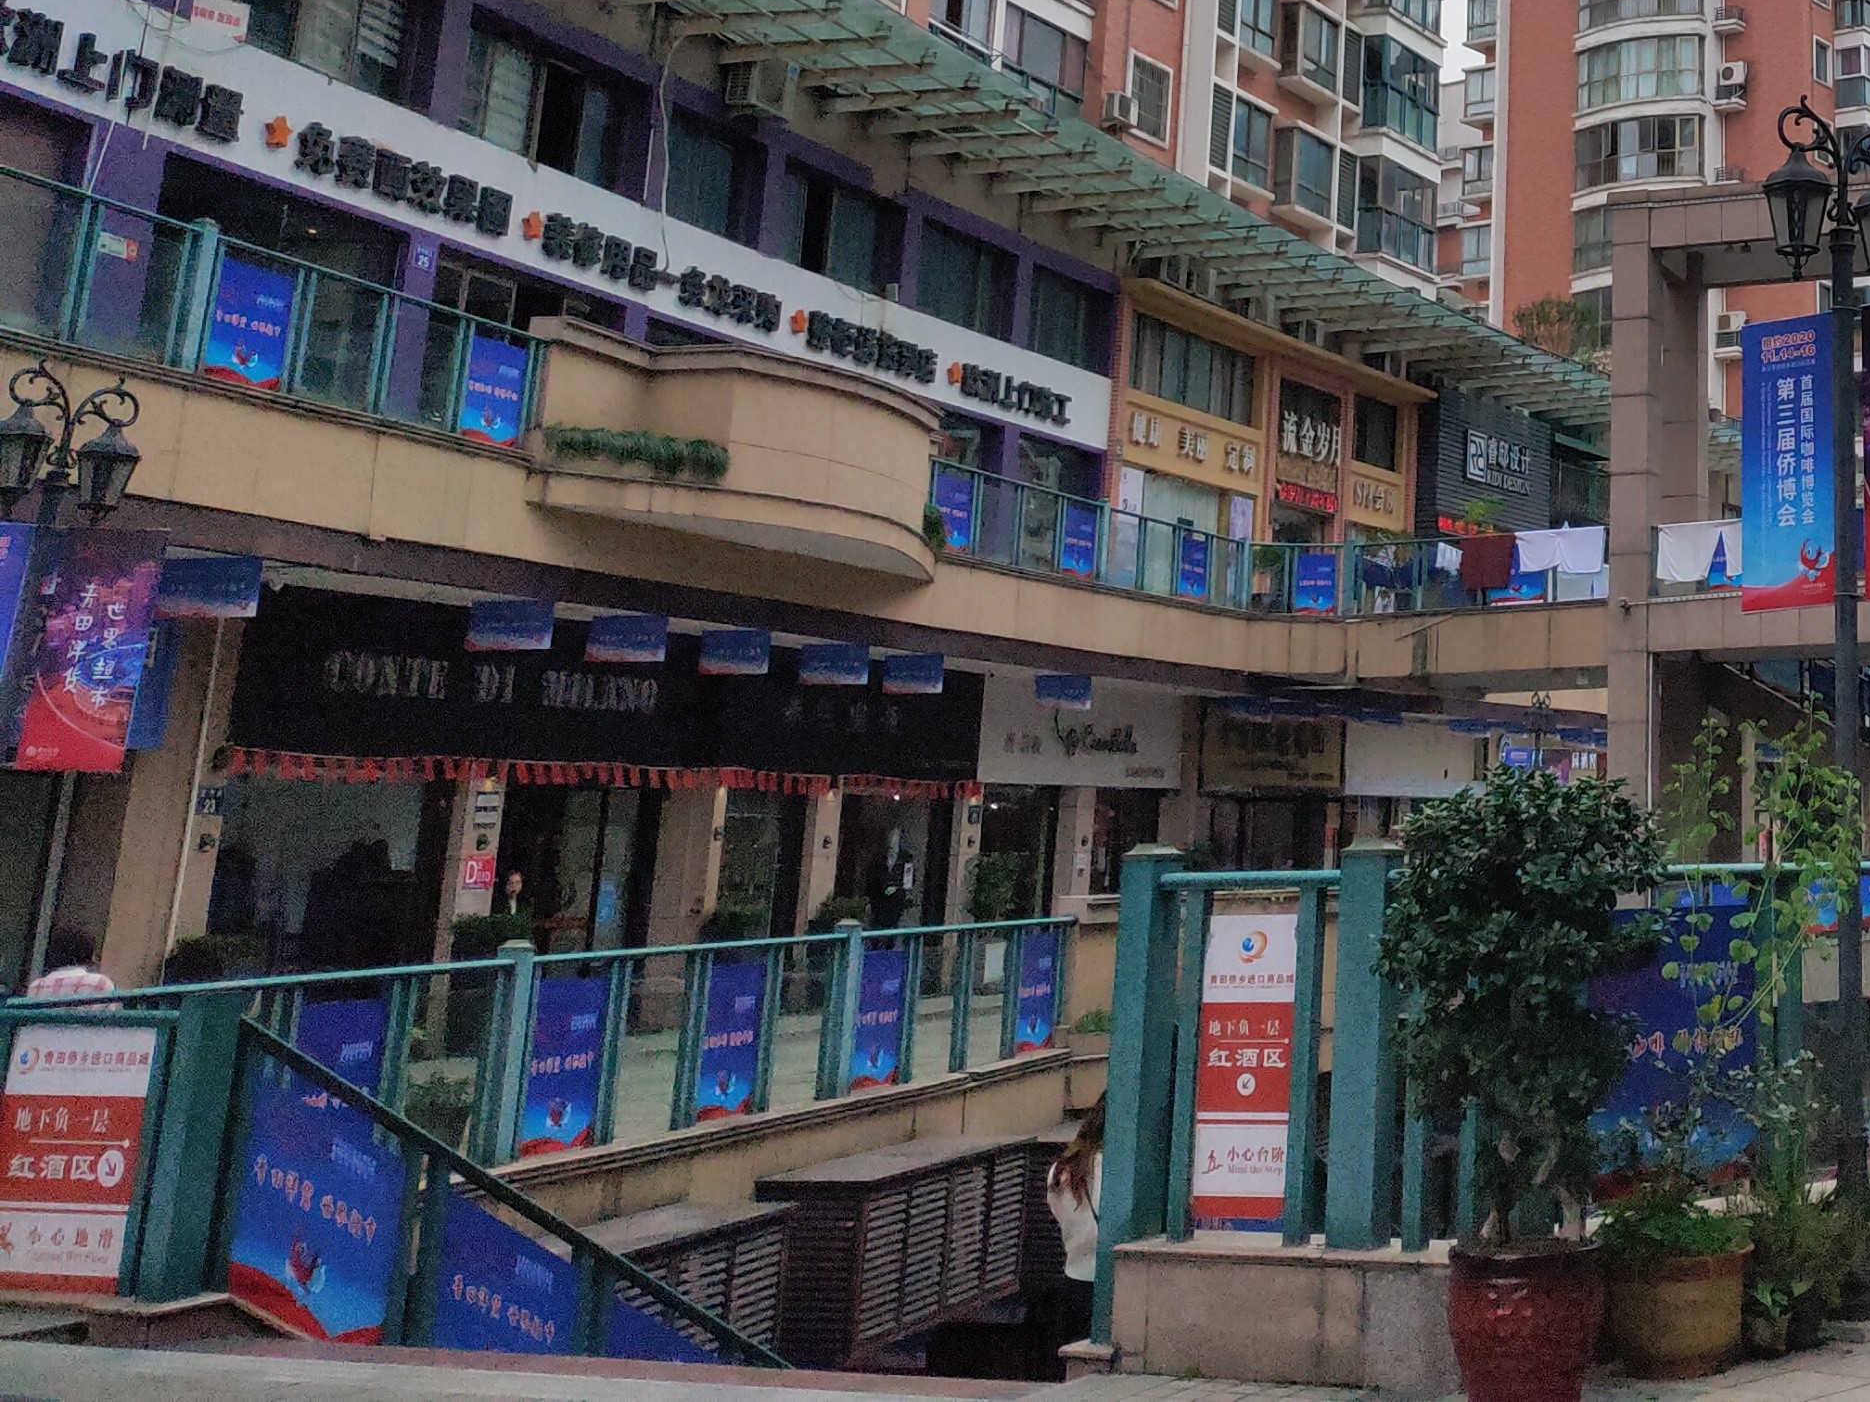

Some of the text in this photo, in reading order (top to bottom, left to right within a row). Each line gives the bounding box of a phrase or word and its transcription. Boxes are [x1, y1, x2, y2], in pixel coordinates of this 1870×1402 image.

[1281, 410, 1342, 466] 流金岁月
[1776, 376, 1797, 527] 第三届侨博会
[1799, 374, 1815, 526] 首届国际咖啡博览会
[1208, 1019, 1281, 1038] 地下负一层
[1207, 1048, 1287, 1069] 红酒区
[13, 1106, 110, 1134] 地下负一层
[7, 1153, 97, 1181] 红酒区
[1226, 1145, 1285, 1164] 小心台阶
